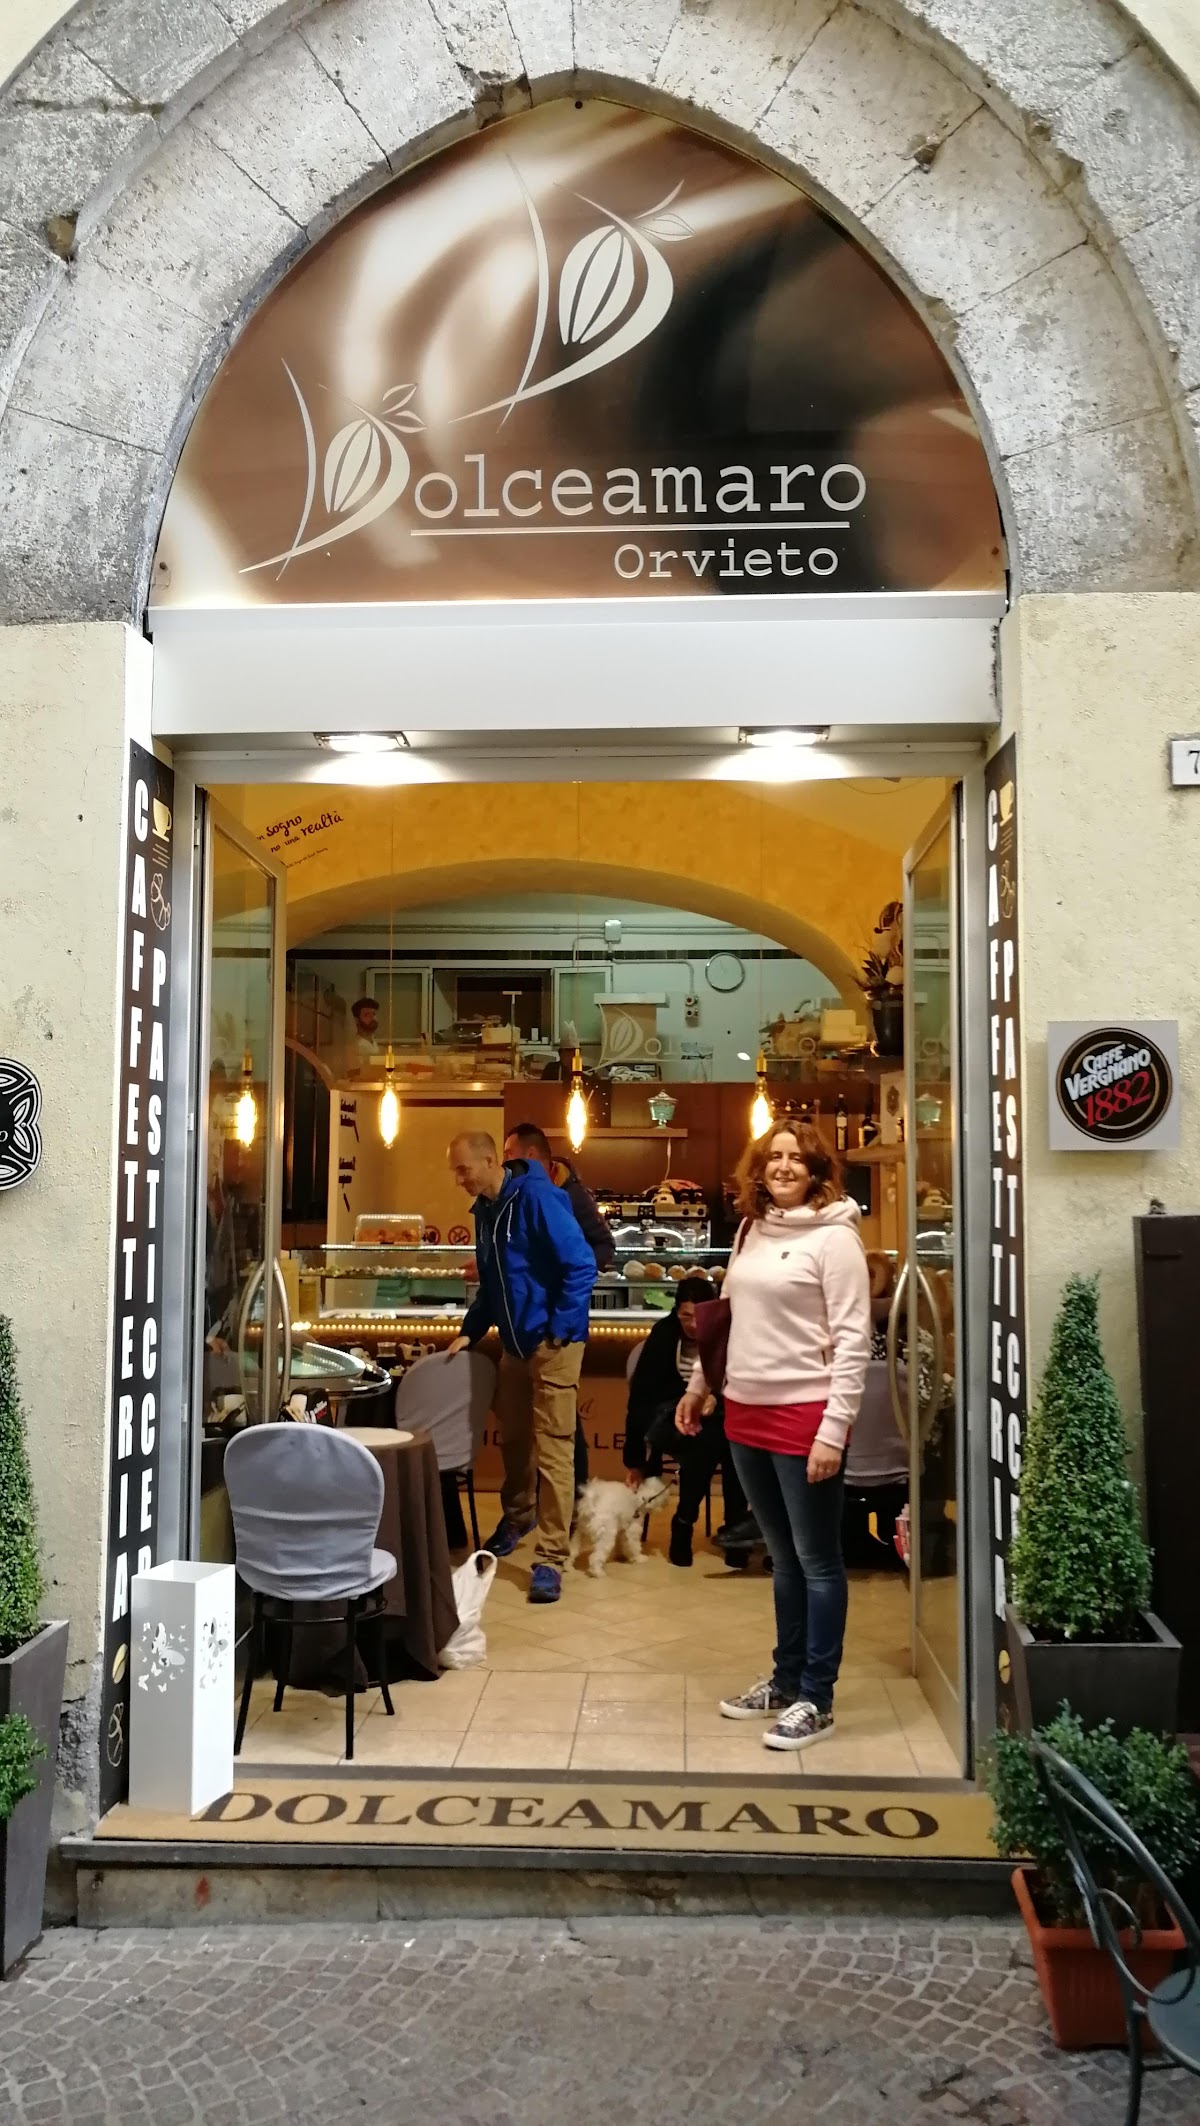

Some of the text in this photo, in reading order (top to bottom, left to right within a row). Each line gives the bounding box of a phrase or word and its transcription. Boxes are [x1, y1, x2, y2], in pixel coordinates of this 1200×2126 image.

[614, 539, 838, 579] Orvieto
[266, 815, 303, 837] sogno
[1064, 1048, 1151, 1101] VERGNANO
[1085, 1071, 1151, 1127] 1882
[112, 778, 149, 1623] CAFFETTERIA
[988, 789, 1006, 1622] CAFFETTERIA
[190, 1791, 939, 1839] DOLCEAMARO
